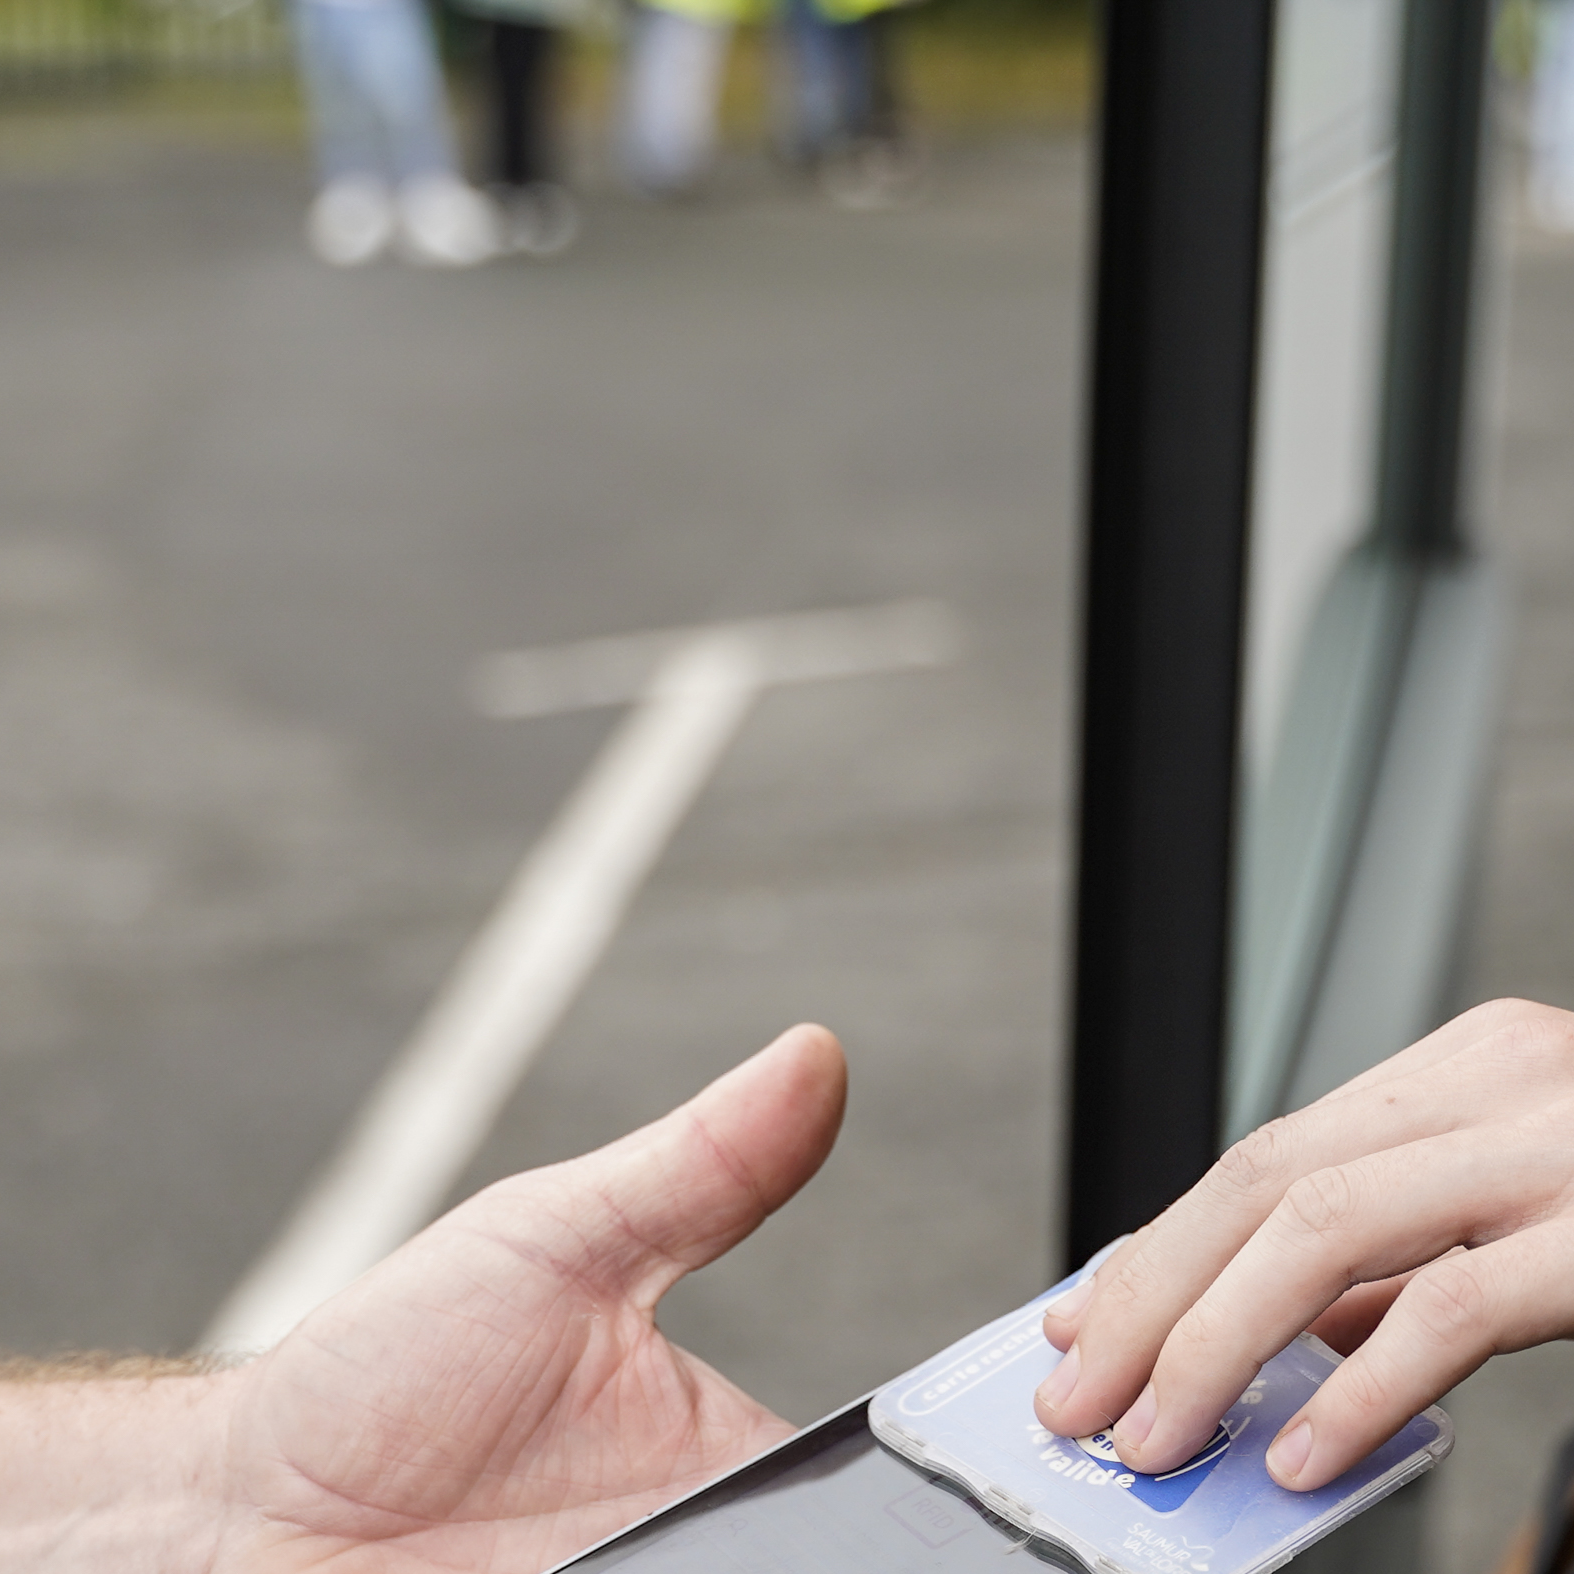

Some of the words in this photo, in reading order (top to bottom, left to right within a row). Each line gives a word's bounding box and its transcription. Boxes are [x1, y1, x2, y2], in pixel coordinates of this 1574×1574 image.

[923, 1363, 980, 1401] carte
[980, 1324, 1042, 1366] recha
[1039, 1445, 1136, 1489] valide
[912, 1498, 954, 1530] RFID
[1123, 1536, 1147, 1557] VAL
[1127, 1522, 1191, 1563] SAUMUR
